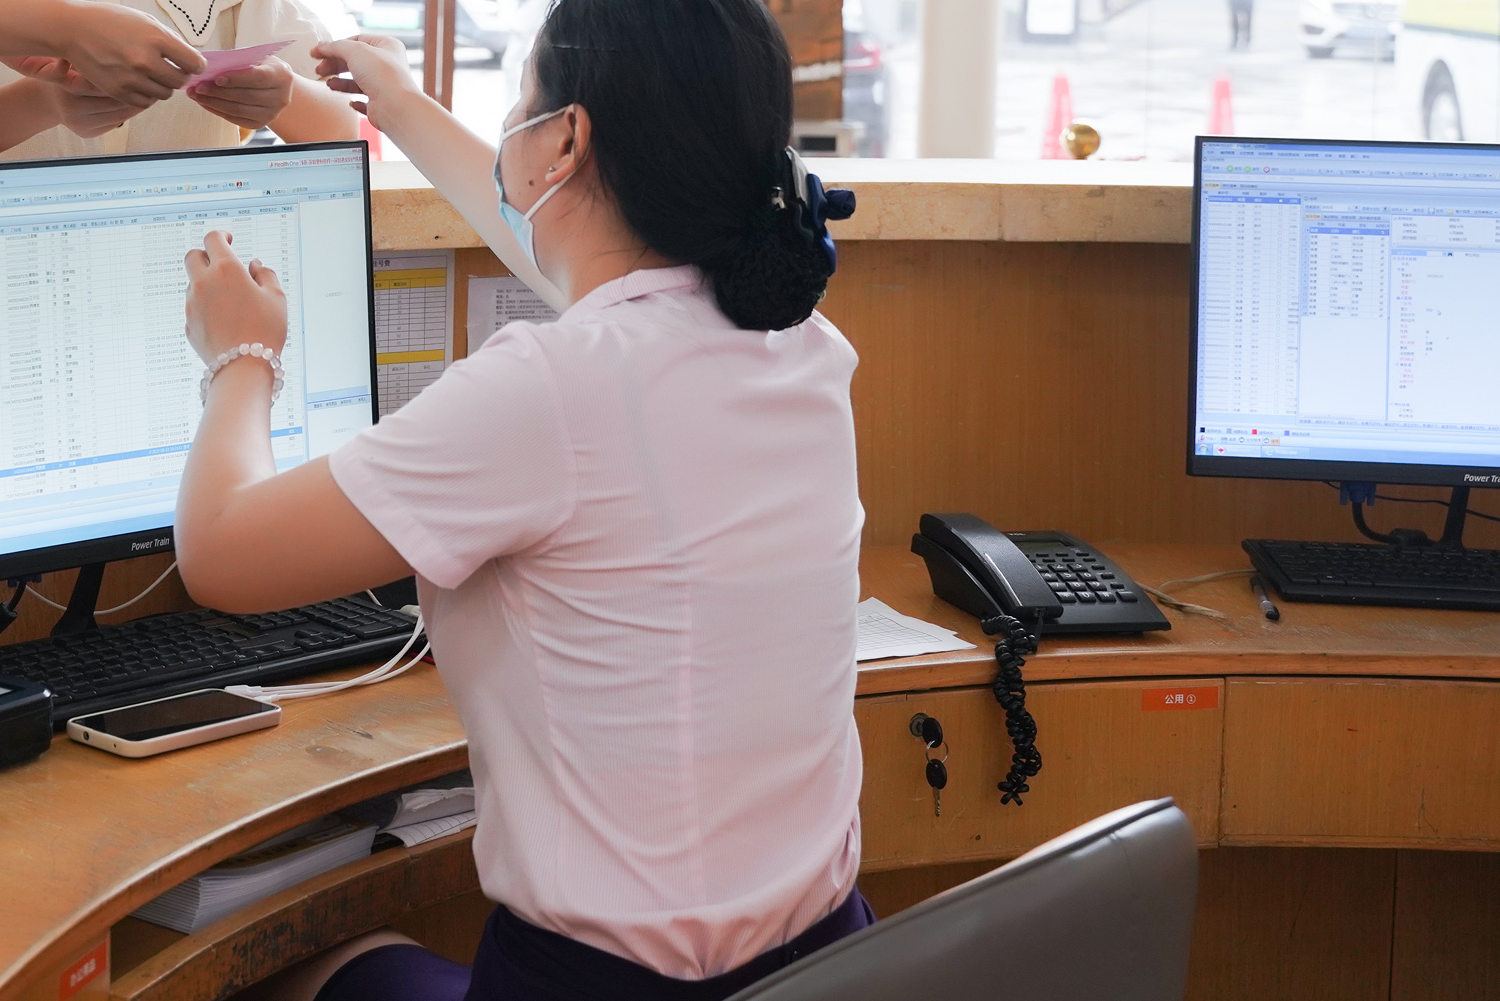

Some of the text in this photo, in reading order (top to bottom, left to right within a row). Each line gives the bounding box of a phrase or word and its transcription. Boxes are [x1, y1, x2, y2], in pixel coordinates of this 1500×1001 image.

[1463, 473, 1490, 482] Power
[131, 537, 170, 551] Power Train
[1164, 694, 1184, 704] 公用
